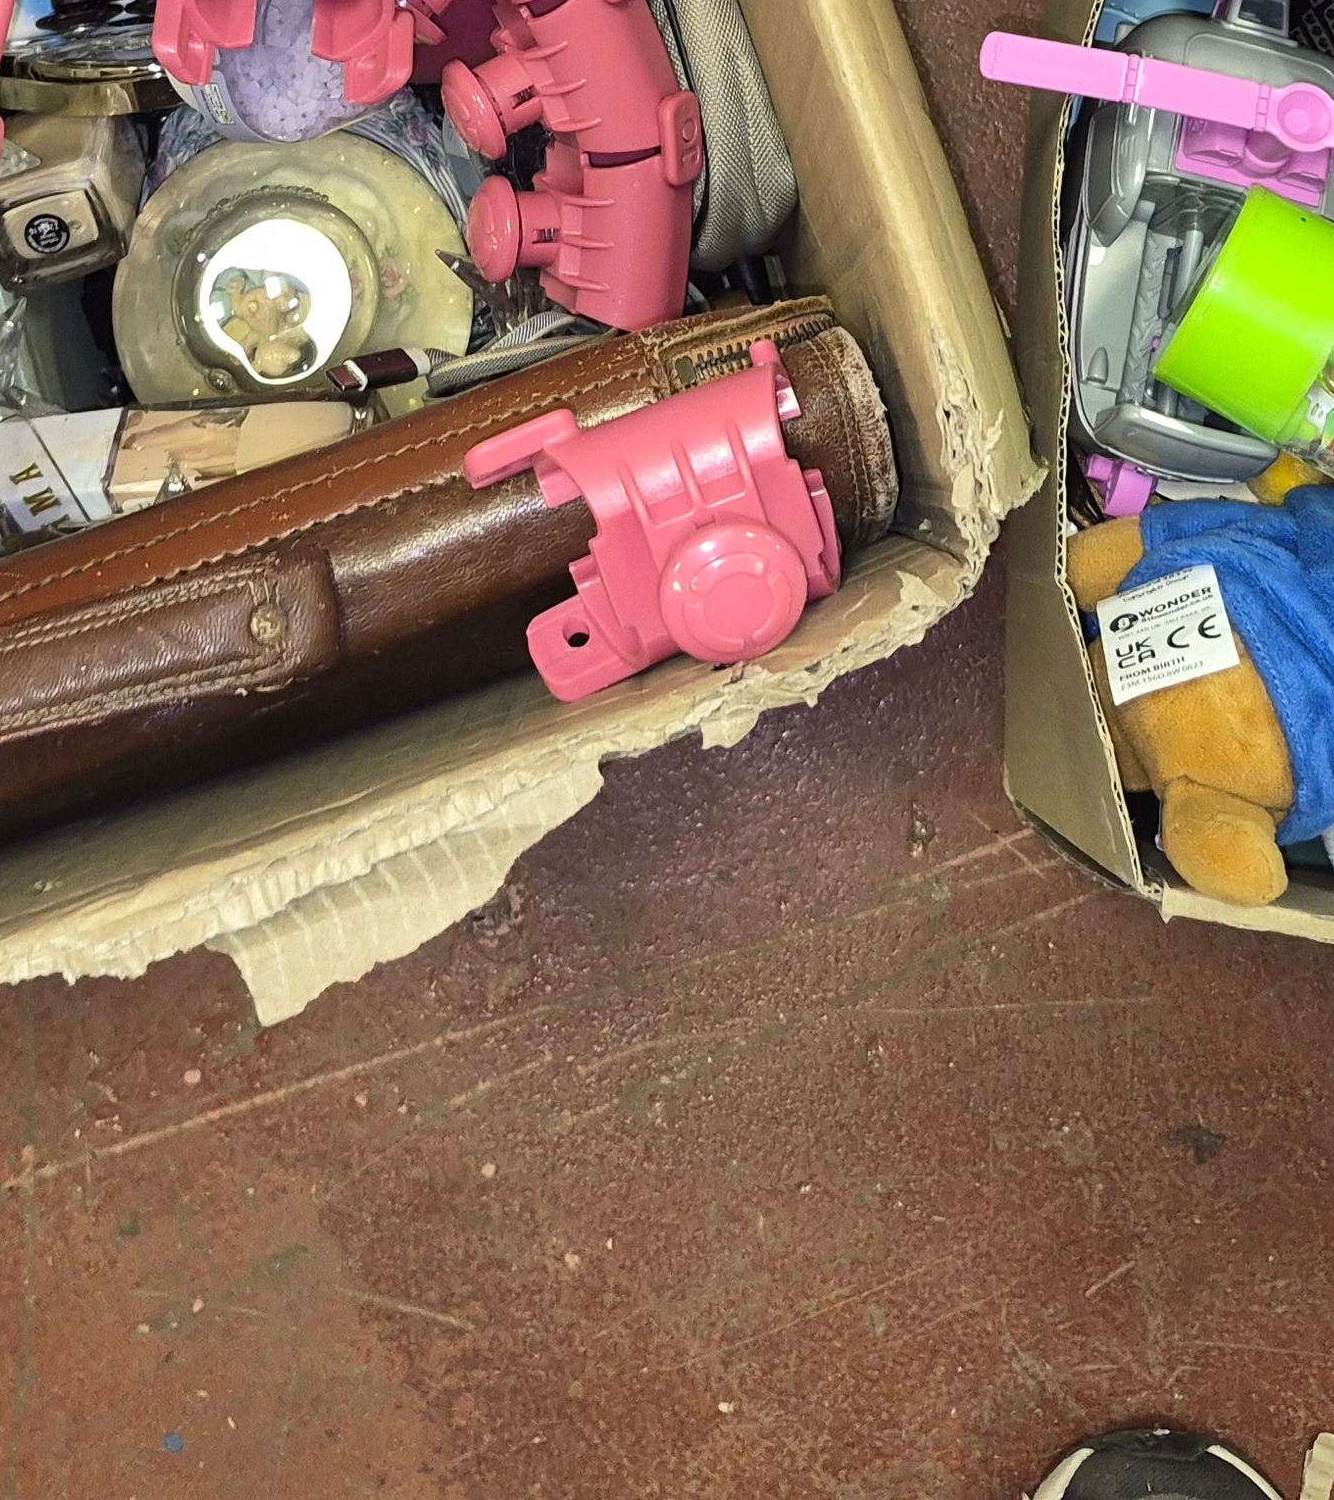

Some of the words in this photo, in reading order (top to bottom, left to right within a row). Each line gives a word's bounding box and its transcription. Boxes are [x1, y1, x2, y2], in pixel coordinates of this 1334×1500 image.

[1138, 586, 1212, 617] WONDER
[1115, 637, 1151, 658] UK
[1119, 666, 1151, 682] FROM
[1151, 654, 1185, 672] BIRTH
